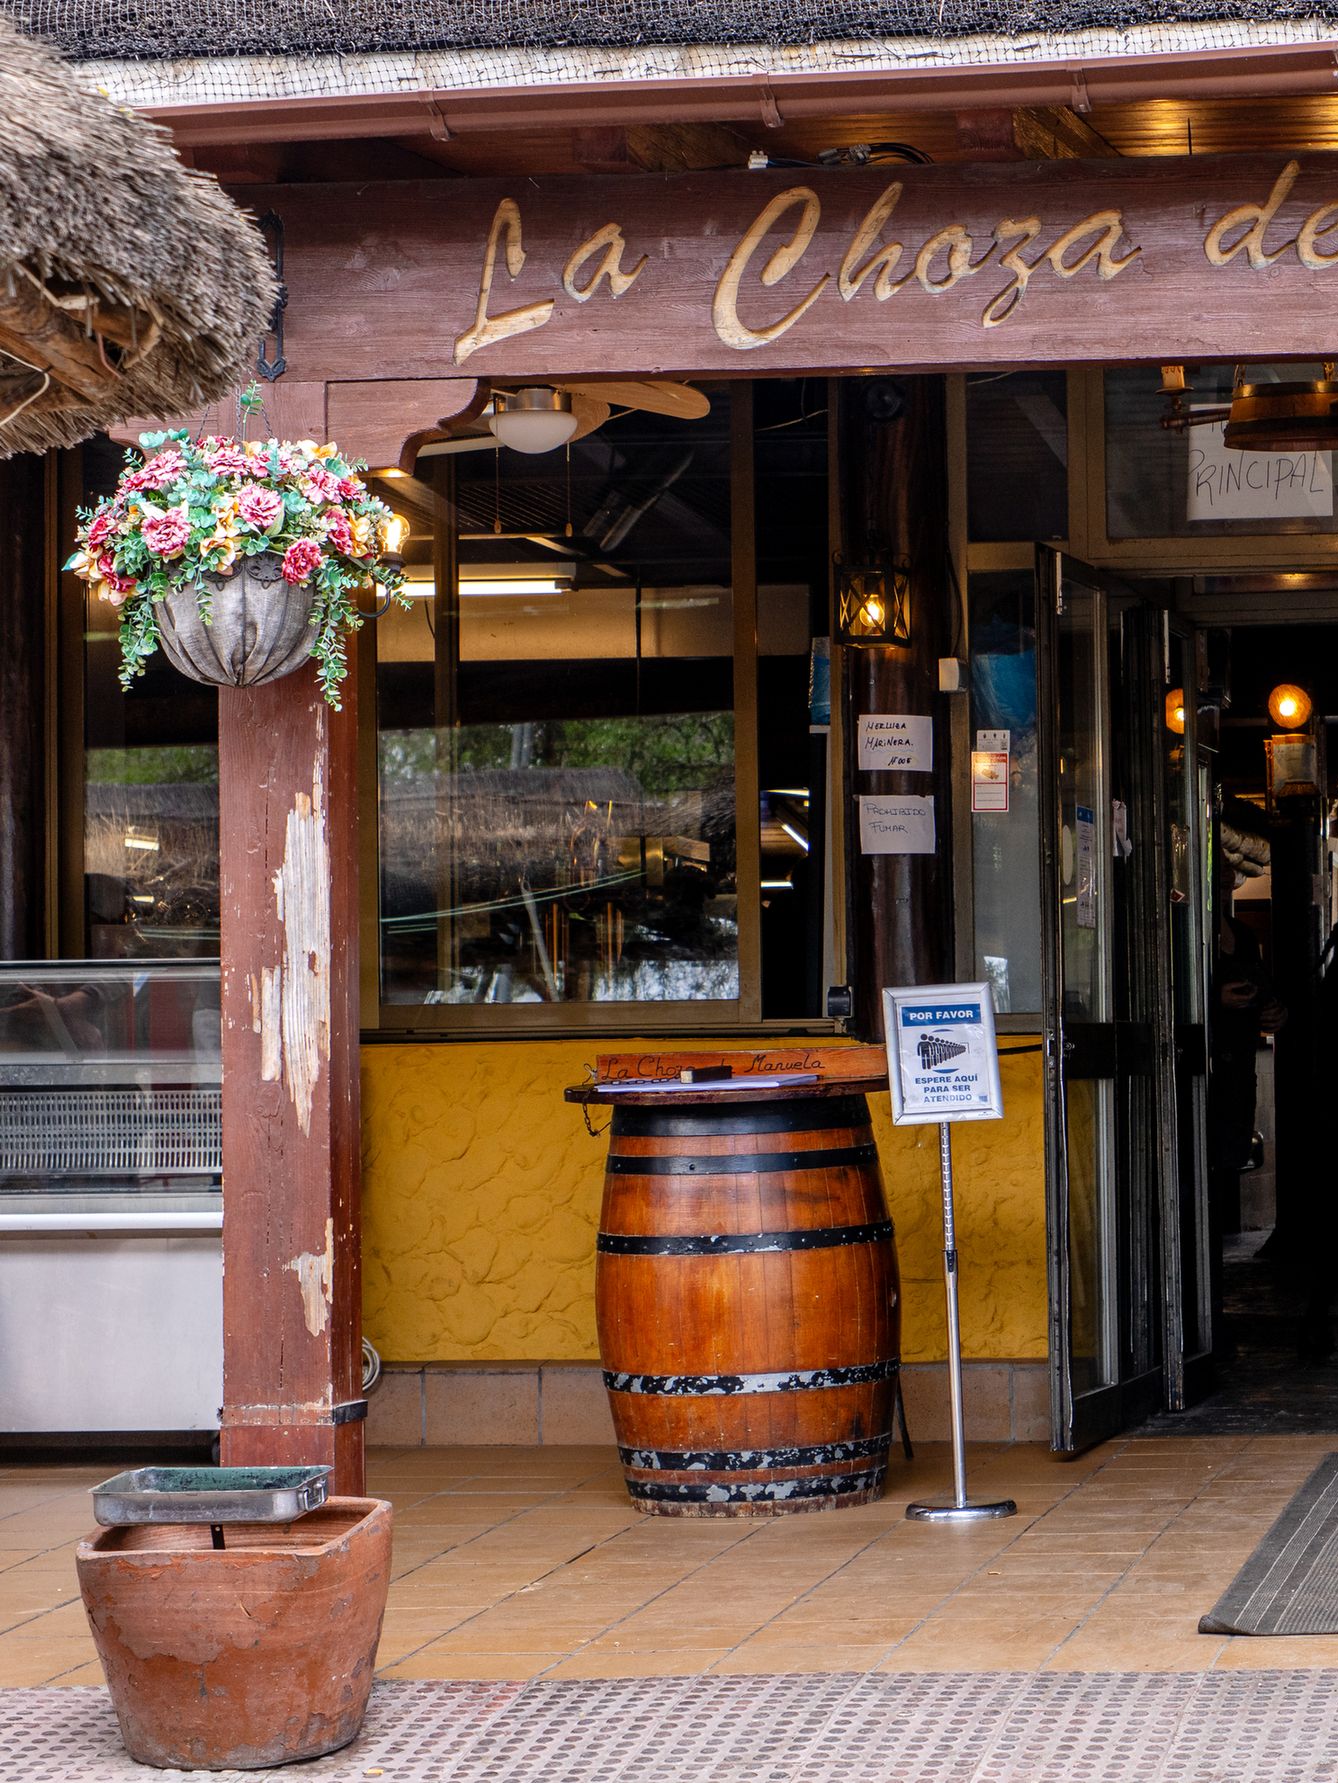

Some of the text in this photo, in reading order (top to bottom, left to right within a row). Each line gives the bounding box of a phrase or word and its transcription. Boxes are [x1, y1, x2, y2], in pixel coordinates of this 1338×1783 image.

[453, 197, 650, 366] La
[712, 181, 1142, 350] Choza
[863, 802, 926, 817] PROHIBIDO
[868, 820, 909, 834] FUMAR
[909, 1010, 974, 1021] POR FAVOR
[601, 1058, 633, 1080] La
[744, 1054, 826, 1073] Manuela
[915, 1073, 978, 1085] ESPERE AQUÍ
[923, 1086, 950, 1094] PARA
[923, 1094, 973, 1104] ATENDIDO
